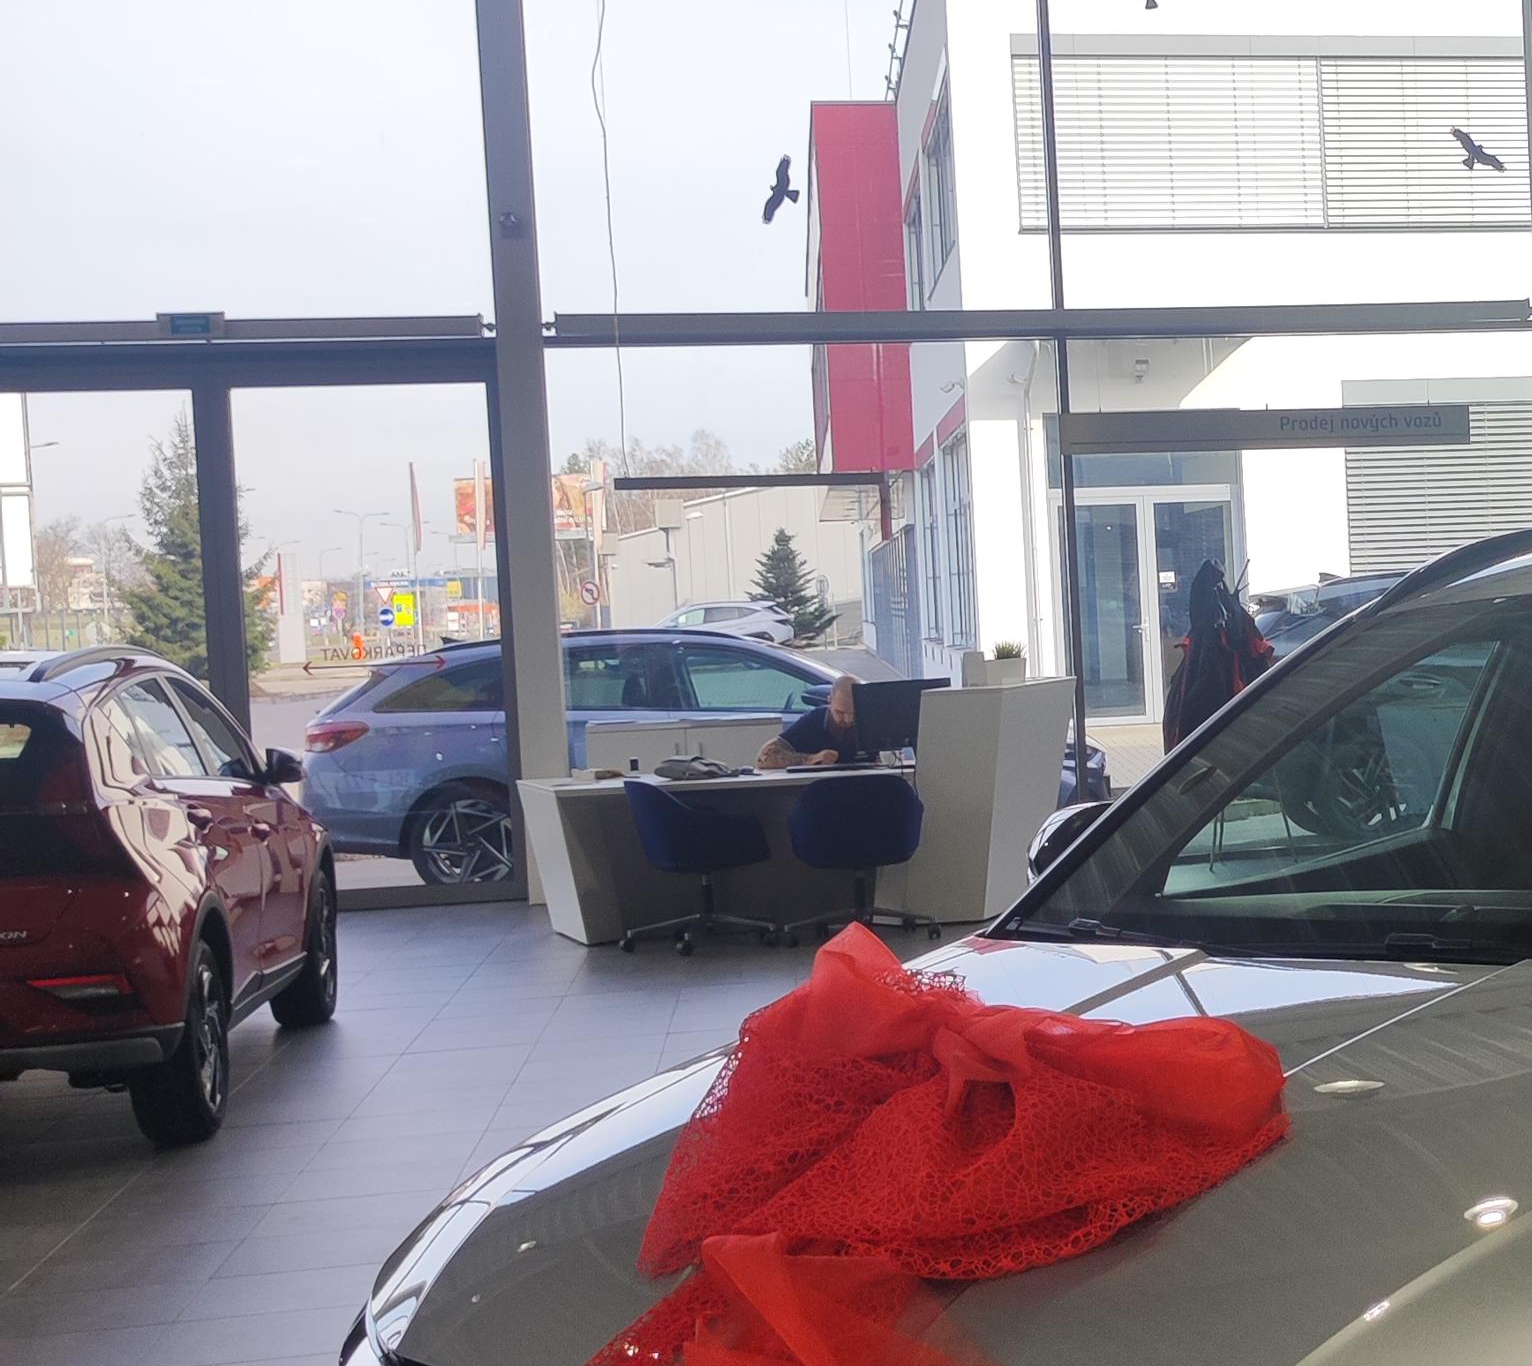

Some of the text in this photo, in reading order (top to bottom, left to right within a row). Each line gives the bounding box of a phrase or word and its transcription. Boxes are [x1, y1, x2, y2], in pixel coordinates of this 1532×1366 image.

[1279, 411, 1442, 433] Prodej nových vozů
